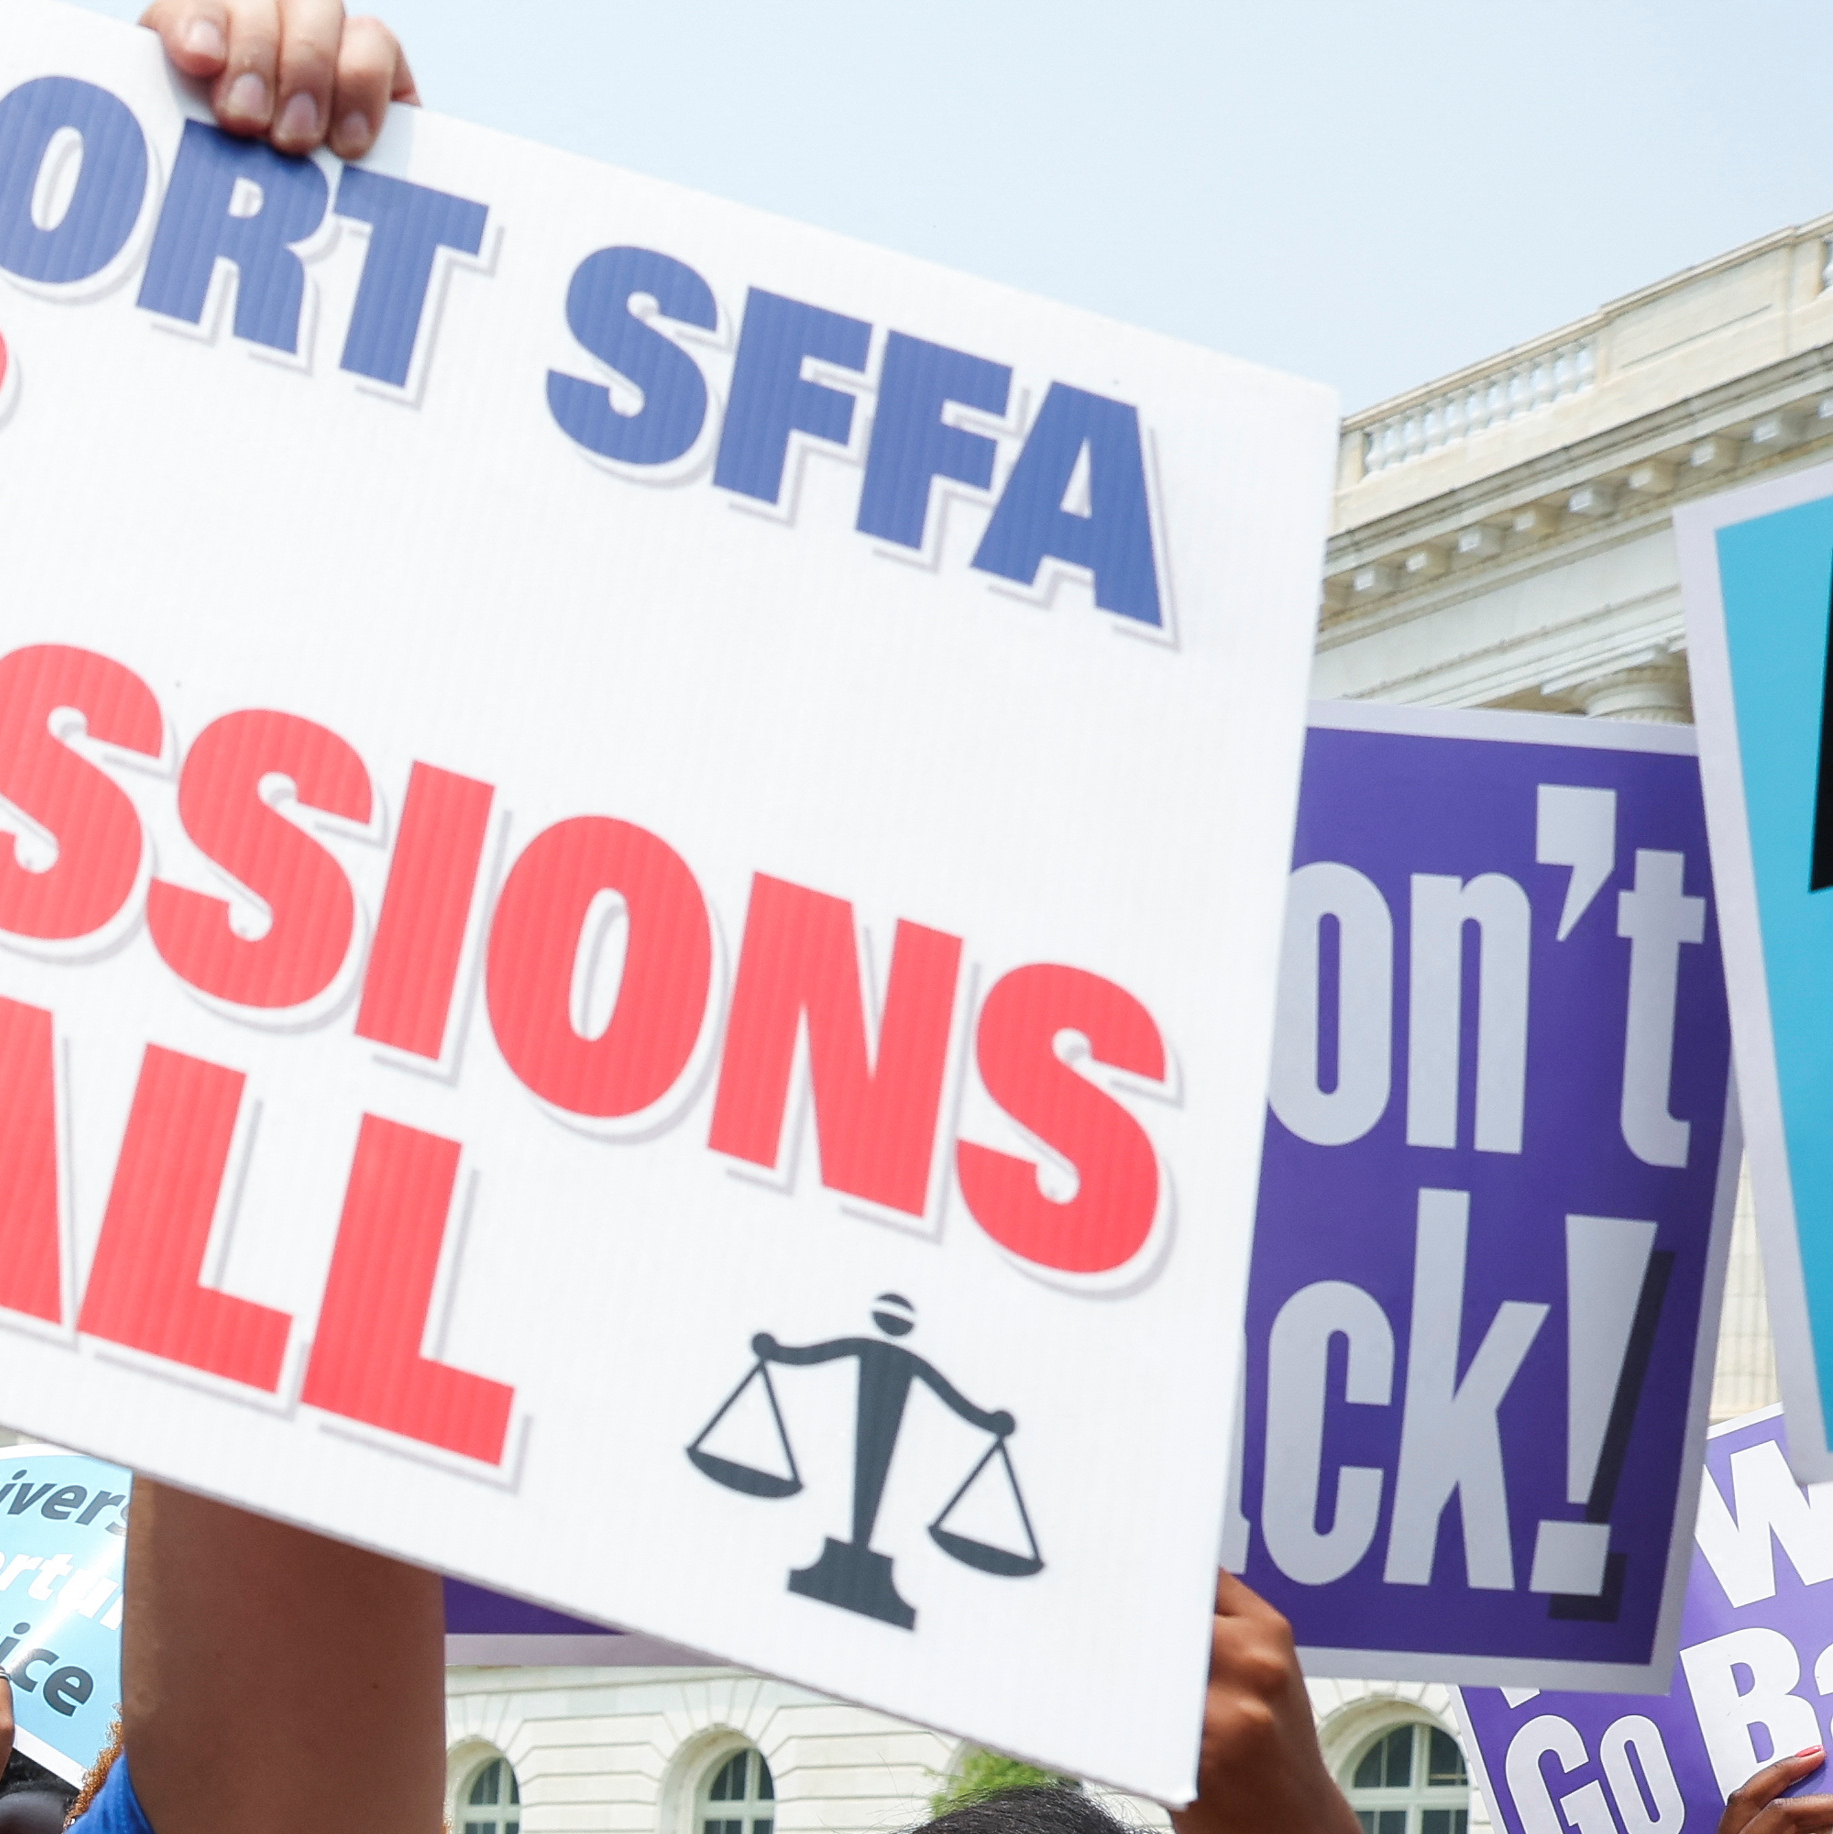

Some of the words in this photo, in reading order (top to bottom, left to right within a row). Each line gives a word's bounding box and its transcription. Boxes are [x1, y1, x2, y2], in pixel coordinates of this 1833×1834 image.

[544, 243, 1166, 632] SFFA
[1265, 783, 1706, 1169] on't
[1228, 1187, 1663, 1598] ck!
